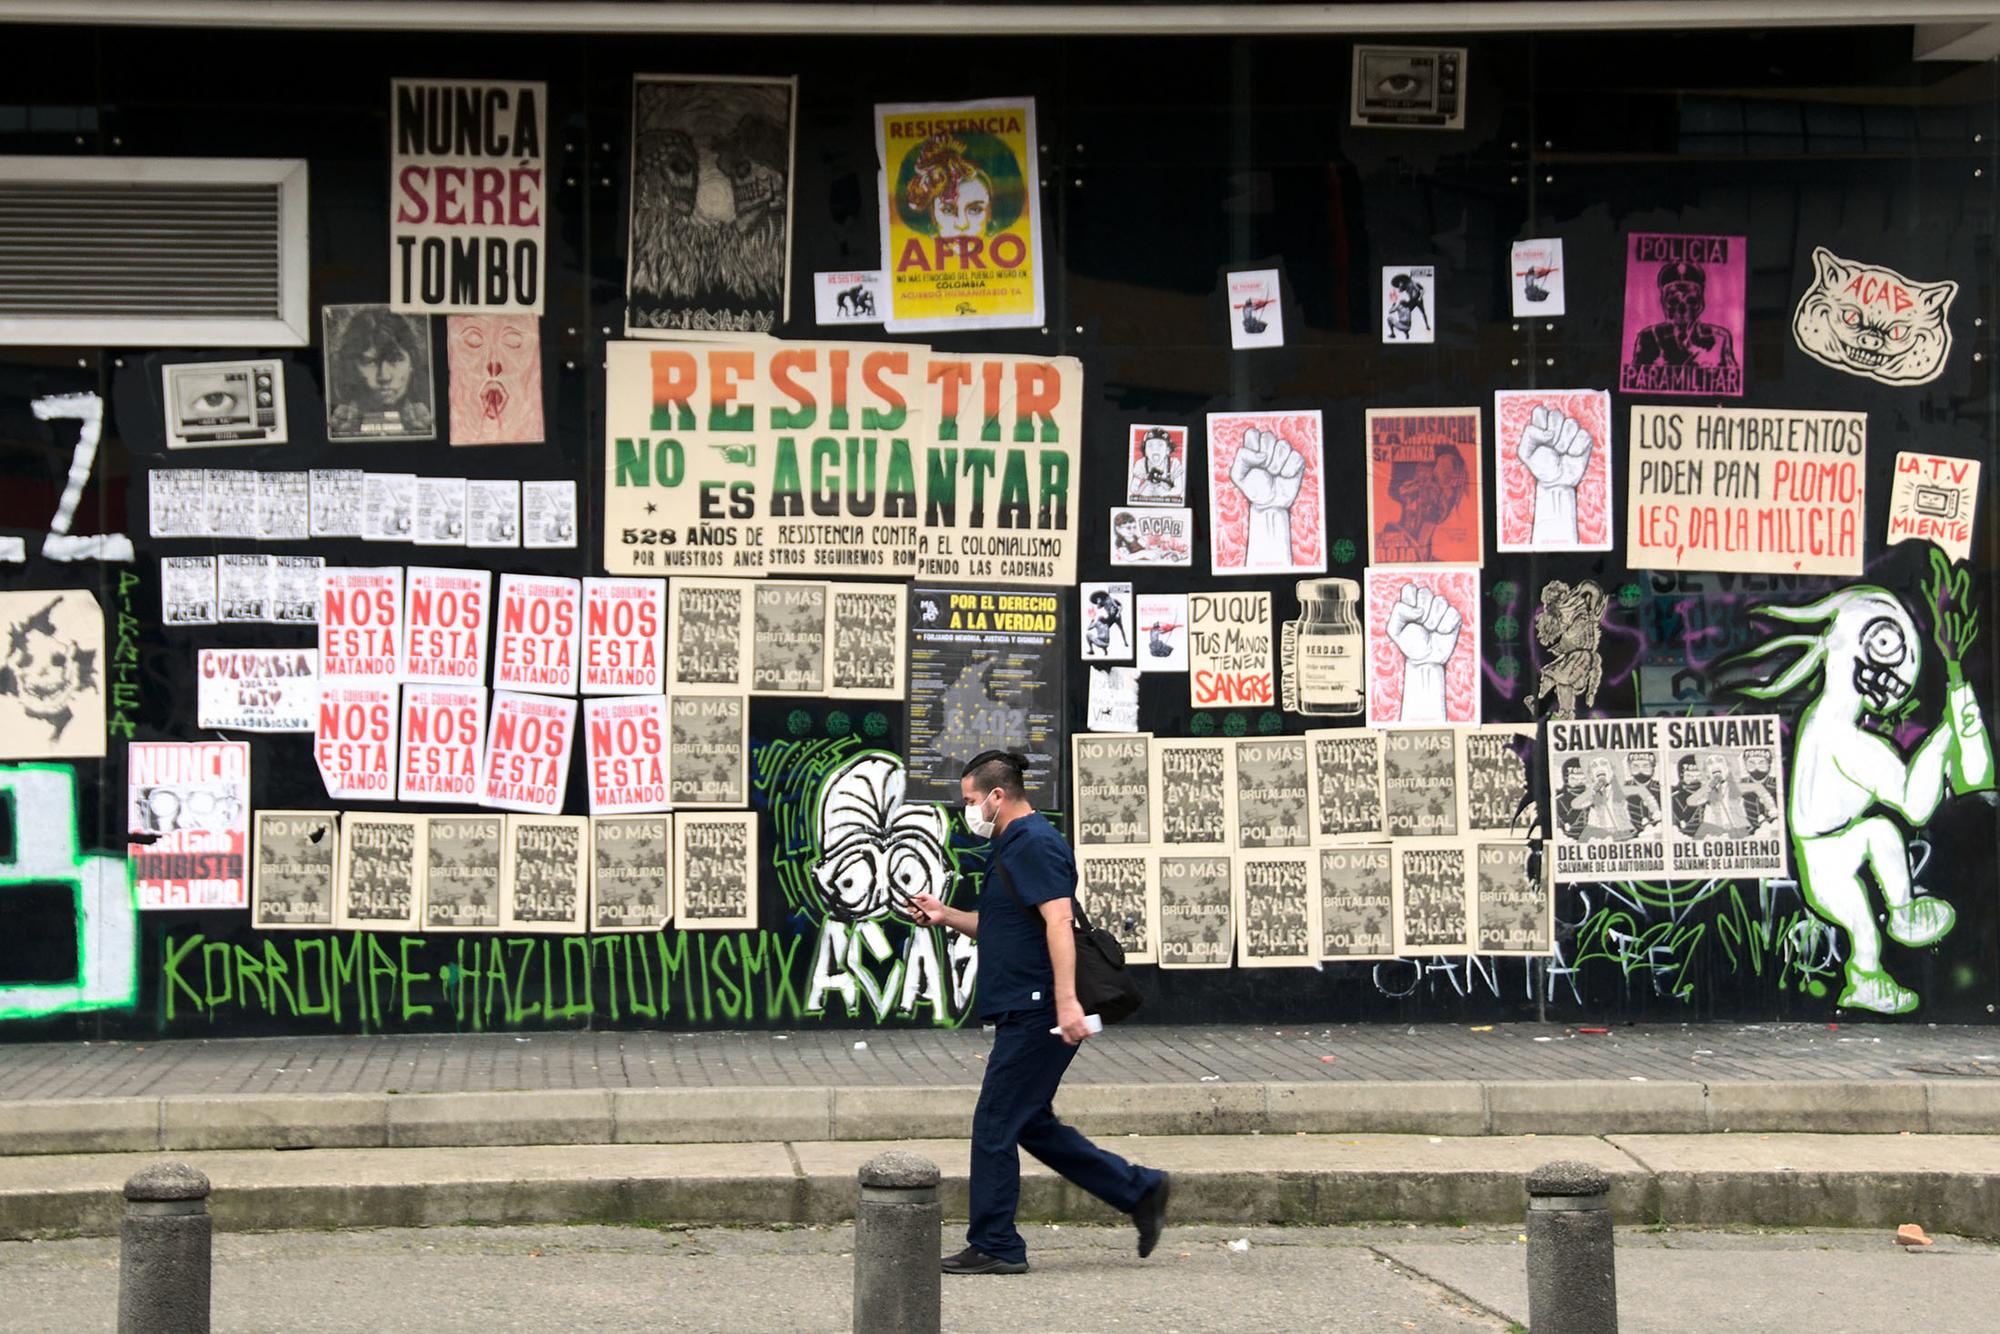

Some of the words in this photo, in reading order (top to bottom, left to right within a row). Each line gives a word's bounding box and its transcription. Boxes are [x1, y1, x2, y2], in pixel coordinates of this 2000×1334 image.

[397, 86, 539, 158] NUNCA
[890, 118, 1021, 139] RESISTENCIA
[397, 160, 541, 227] SERÉ
[898, 233, 1027, 272] AFRO
[397, 235, 538, 305] TOMBO
[936, 281, 985, 289] COLOMBIA
[1845, 276, 1912, 314] ACAB
[1626, 366, 1739, 393] PARAMILITAR
[650, 348, 1061, 443] RESISTIR
[1640, 414, 1683, 449] LOS
[1697, 416, 1863, 455] HAMBRIENTOS
[1640, 459, 1703, 496] PIDEN
[1714, 460, 1760, 499] PAN
[1897, 456, 1920, 474] LA
[1928, 459, 1970, 485] TV
[615, 438, 685, 487] NO
[700, 481, 755, 519] ES
[769, 437, 1068, 529] AGUANTAR
[1689, 506, 1719, 551] DA
[1725, 507, 1749, 552] LA
[1758, 507, 1856, 557] MILICIA
[1891, 515, 1969, 542] MIENTE
[621, 528, 677, 546] 528
[686, 523, 737, 546] AÑOS
[746, 526, 763, 546] DE
[778, 525, 864, 546] RESISTENCIA
[872, 525, 928, 554] CONTRA
[937, 536, 954, 555] EL
[961, 536, 1062, 558] COLONIALISMO
[633, 550, 654, 566] POR
[665, 550, 723, 566] NUESTROS
[734, 549, 805, 566] ANCESTROS
[814, 550, 884, 565] SEGUIREMOS
[893, 549, 959, 575] ROMPIENDO
[969, 560, 992, 575] LAS
[1000, 560, 1054, 577] CADENAS
[756, 591, 780, 604] NO
[951, 595, 976, 609] POR
[981, 596, 994, 610] EL
[999, 597, 1057, 612] DERECHO
[325, 590, 395, 626] NOS
[410, 591, 481, 629] NOS
[503, 597, 573, 637] NOS
[1191, 596, 1268, 624] DUQUE
[588, 600, 657, 637] NOS
[951, 612, 962, 629] A
[967, 612, 987, 630] LA
[994, 613, 1056, 631] VERDAD
[756, 633, 822, 642] BRUTALIDAD
[1192, 631, 1221, 655] TUS
[1225, 628, 1268, 655] MANOS
[1284, 621, 1297, 668] VACUNA
[326, 658, 396, 675] MATANDO
[408, 659, 478, 677] MATANDO
[1209, 656, 1266, 669] TIENEN
[500, 665, 570, 685] MATANDO
[587, 669, 656, 686] MATANDO
[755, 670, 820, 682] POLICIAL
[1196, 670, 1272, 703] SANGRE
[1284, 672, 1295, 710] SANTA
[674, 703, 697, 716] NO
[320, 703, 390, 741] NOS
[407, 707, 477, 745] NOS
[493, 713, 564, 756] NOS
[592, 718, 662, 757] NOS
[1387, 737, 1410, 750] NO
[673, 744, 740, 753] BRUTALIDAD
[1080, 745, 1107, 758] NO
[1239, 748, 1262, 762] NO
[133, 746, 244, 784] NUNCA
[405, 774, 475, 793] MATANDO
[672, 782, 738, 794] POLICIAL
[1080, 785, 1146, 795] BRUTALIDAD
[1387, 778, 1453, 787] BRUTALIDAD
[486, 780, 556, 805] MATANDO
[595, 786, 665, 806] MATANDO
[1240, 788, 1305, 799] BRUTALIDAD
[1081, 823, 1147, 836] POLICIAL
[1388, 815, 1454, 828] POLICIAL
[598, 826, 622, 840] NO
[1240, 827, 1306, 840] POLICIAL
[1558, 845, 1583, 860] DEL
[1588, 843, 1663, 859] GOBIERNO
[1673, 843, 1698, 857] DEL
[1703, 841, 1779, 857] GOBIERNO
[134, 854, 242, 879] URIBISTA
[1162, 863, 1186, 877] NO
[1323, 855, 1347, 869] NO
[1596, 861, 1606, 872] DE
[1607, 861, 1617, 872] LA
[1618, 860, 1664, 872] AUTORIDAD
[1711, 858, 1721, 870] DE
[1723, 858, 1731, 869] LA
[1734, 857, 1780, 869] AUTORIDAD
[598, 867, 664, 877] BRUTALIDAD
[1163, 905, 1229, 915] BRUTALIDAD
[1324, 897, 1389, 907] BRUTALIDAD
[599, 905, 665, 919] POLICIAL
[1163, 943, 1228, 956] POLICIAL
[1325, 934, 1391, 947] POLICIAL
